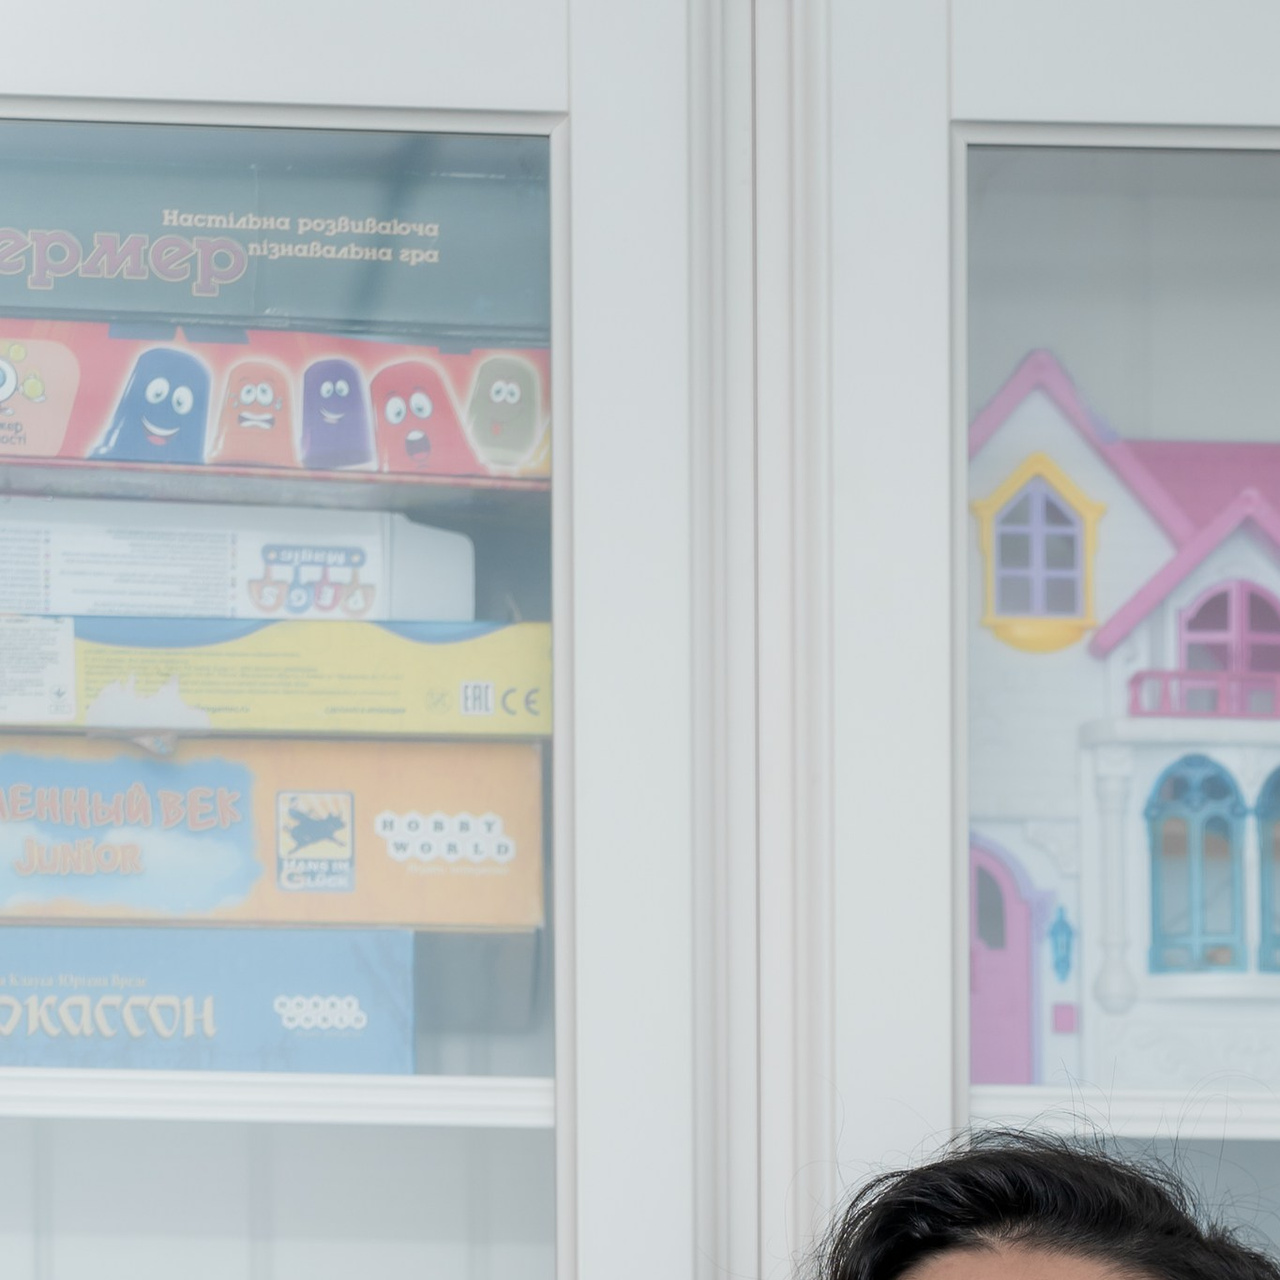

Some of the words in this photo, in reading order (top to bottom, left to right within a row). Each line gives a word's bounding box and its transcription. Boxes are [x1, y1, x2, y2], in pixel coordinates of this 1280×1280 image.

[161, 208, 291, 230] Настільна
[297, 216, 440, 237] розвиваюча
[247, 239, 393, 261] пізнавальна
[399, 247, 440, 266] гра
[158, 786, 241, 831] ВЕК
